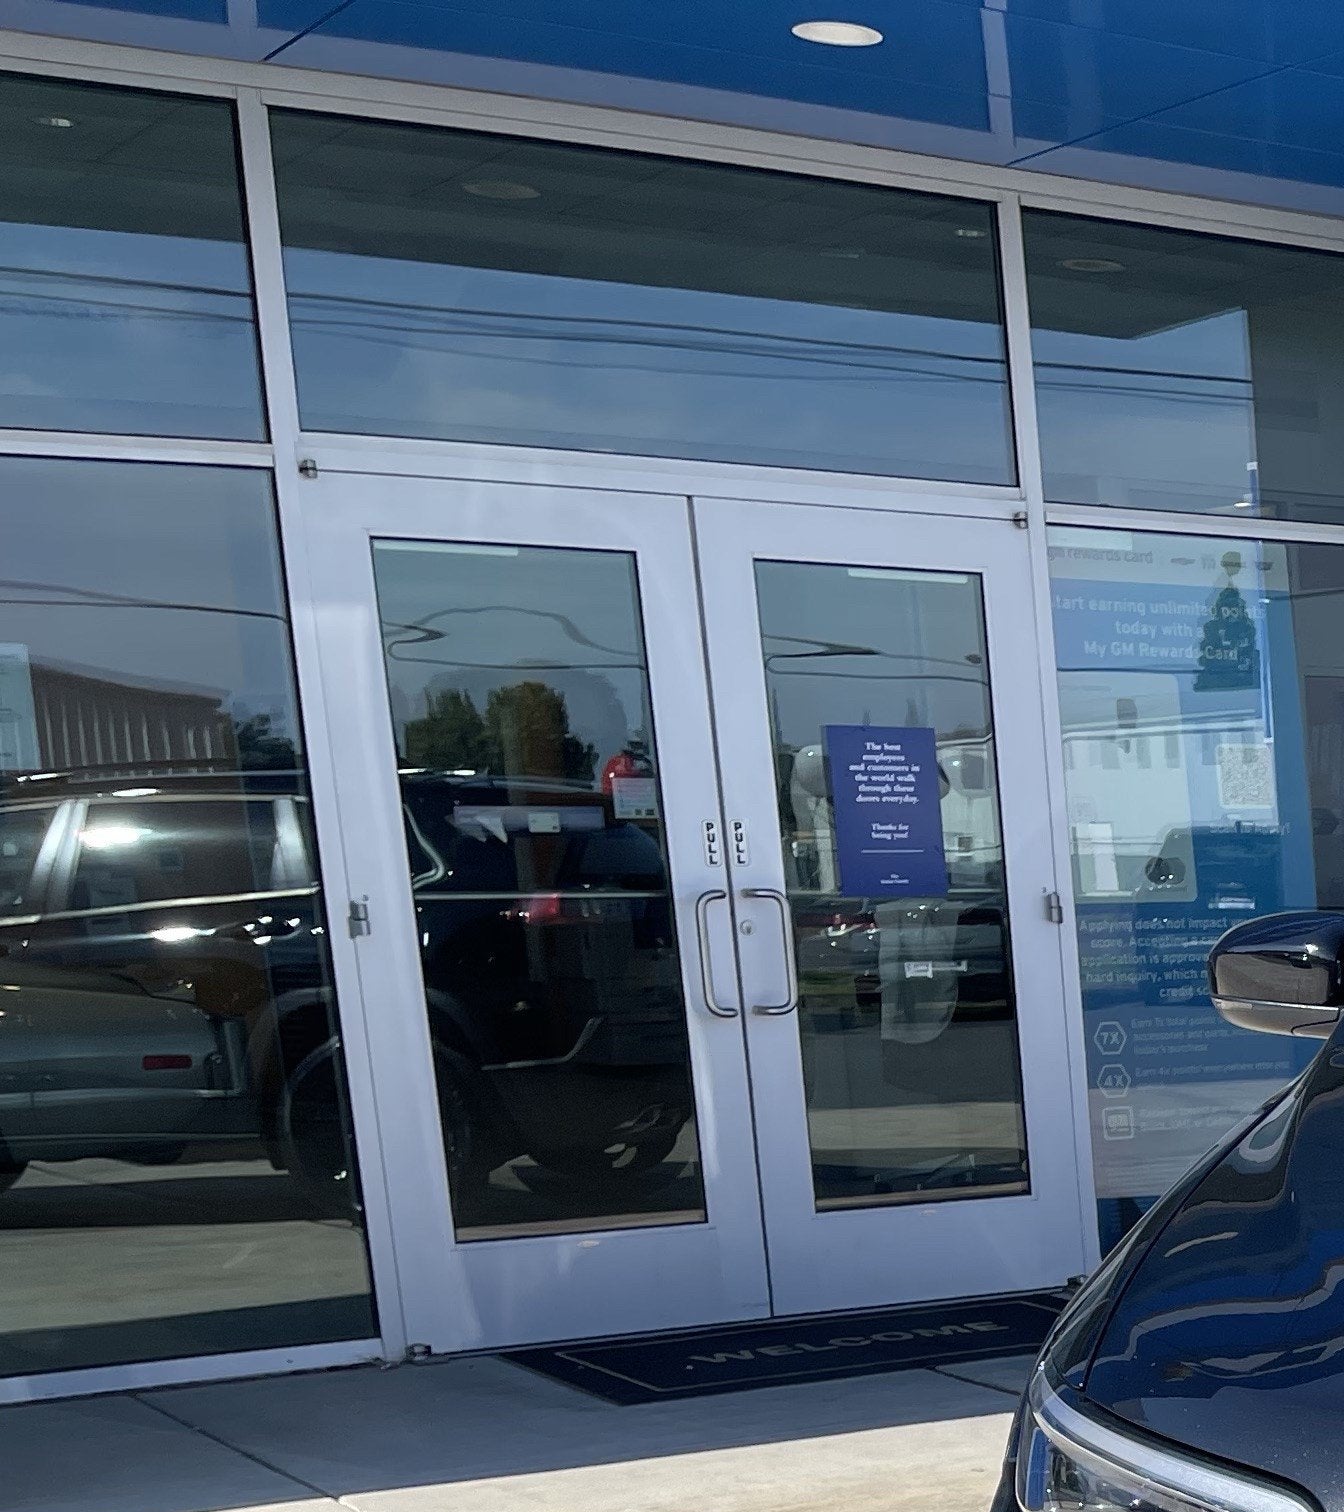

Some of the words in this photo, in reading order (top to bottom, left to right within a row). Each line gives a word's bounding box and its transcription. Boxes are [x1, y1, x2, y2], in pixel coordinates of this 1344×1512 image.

[1054, 596, 1084, 610] tart
[1088, 598, 1146, 616] earning
[1115, 620, 1157, 639] today
[1162, 623, 1192, 637] with
[1083, 640, 1106, 657] My
[1110, 641, 1135, 656] GM
[1139, 642, 1203, 658] Rewards
[1204, 645, 1238, 660] Card
[865, 742, 881, 751] The
[849, 763, 865, 771] and
[910, 763, 920, 772] in
[854, 773, 868, 781] the
[870, 773, 894, 782] world
[896, 773, 916, 782] walk
[858, 784, 892, 793] through
[705, 821, 718, 865] PULL
[733, 821, 746, 864] PULL
[688, 1321, 1010, 1363] WELCOME
